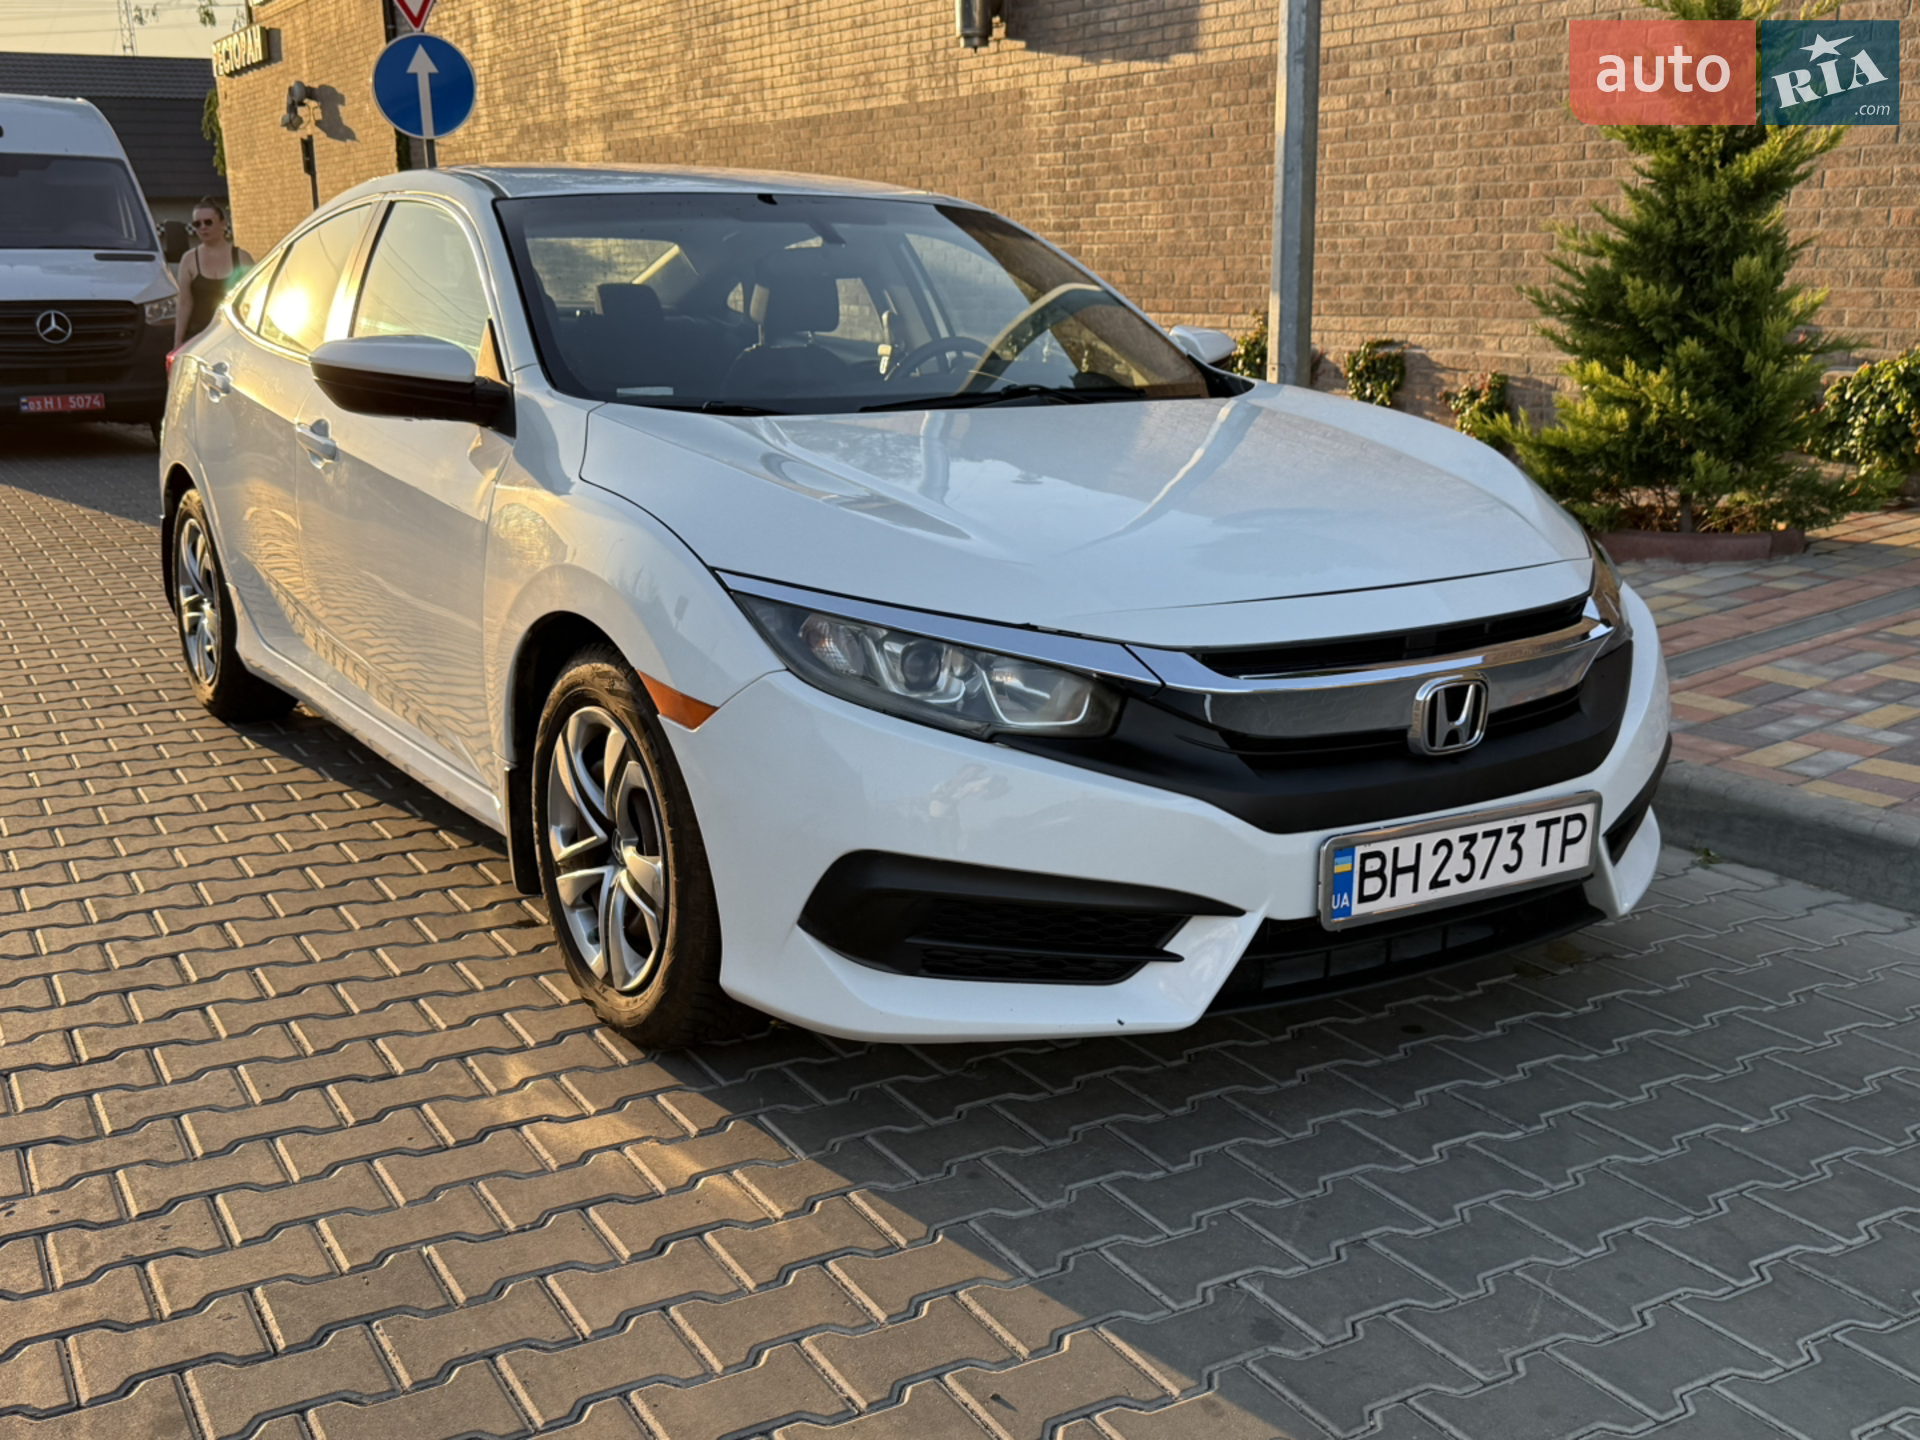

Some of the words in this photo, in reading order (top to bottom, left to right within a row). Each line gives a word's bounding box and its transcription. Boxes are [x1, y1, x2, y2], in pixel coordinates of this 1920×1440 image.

[211, 24, 263, 77] РЕСТОРАН
[69, 395, 101, 409] 5074
[1357, 842, 1422, 904] BH
[1428, 824, 1525, 890] 2373
[1536, 813, 1588, 867] TP
[1331, 892, 1350, 910] UA
